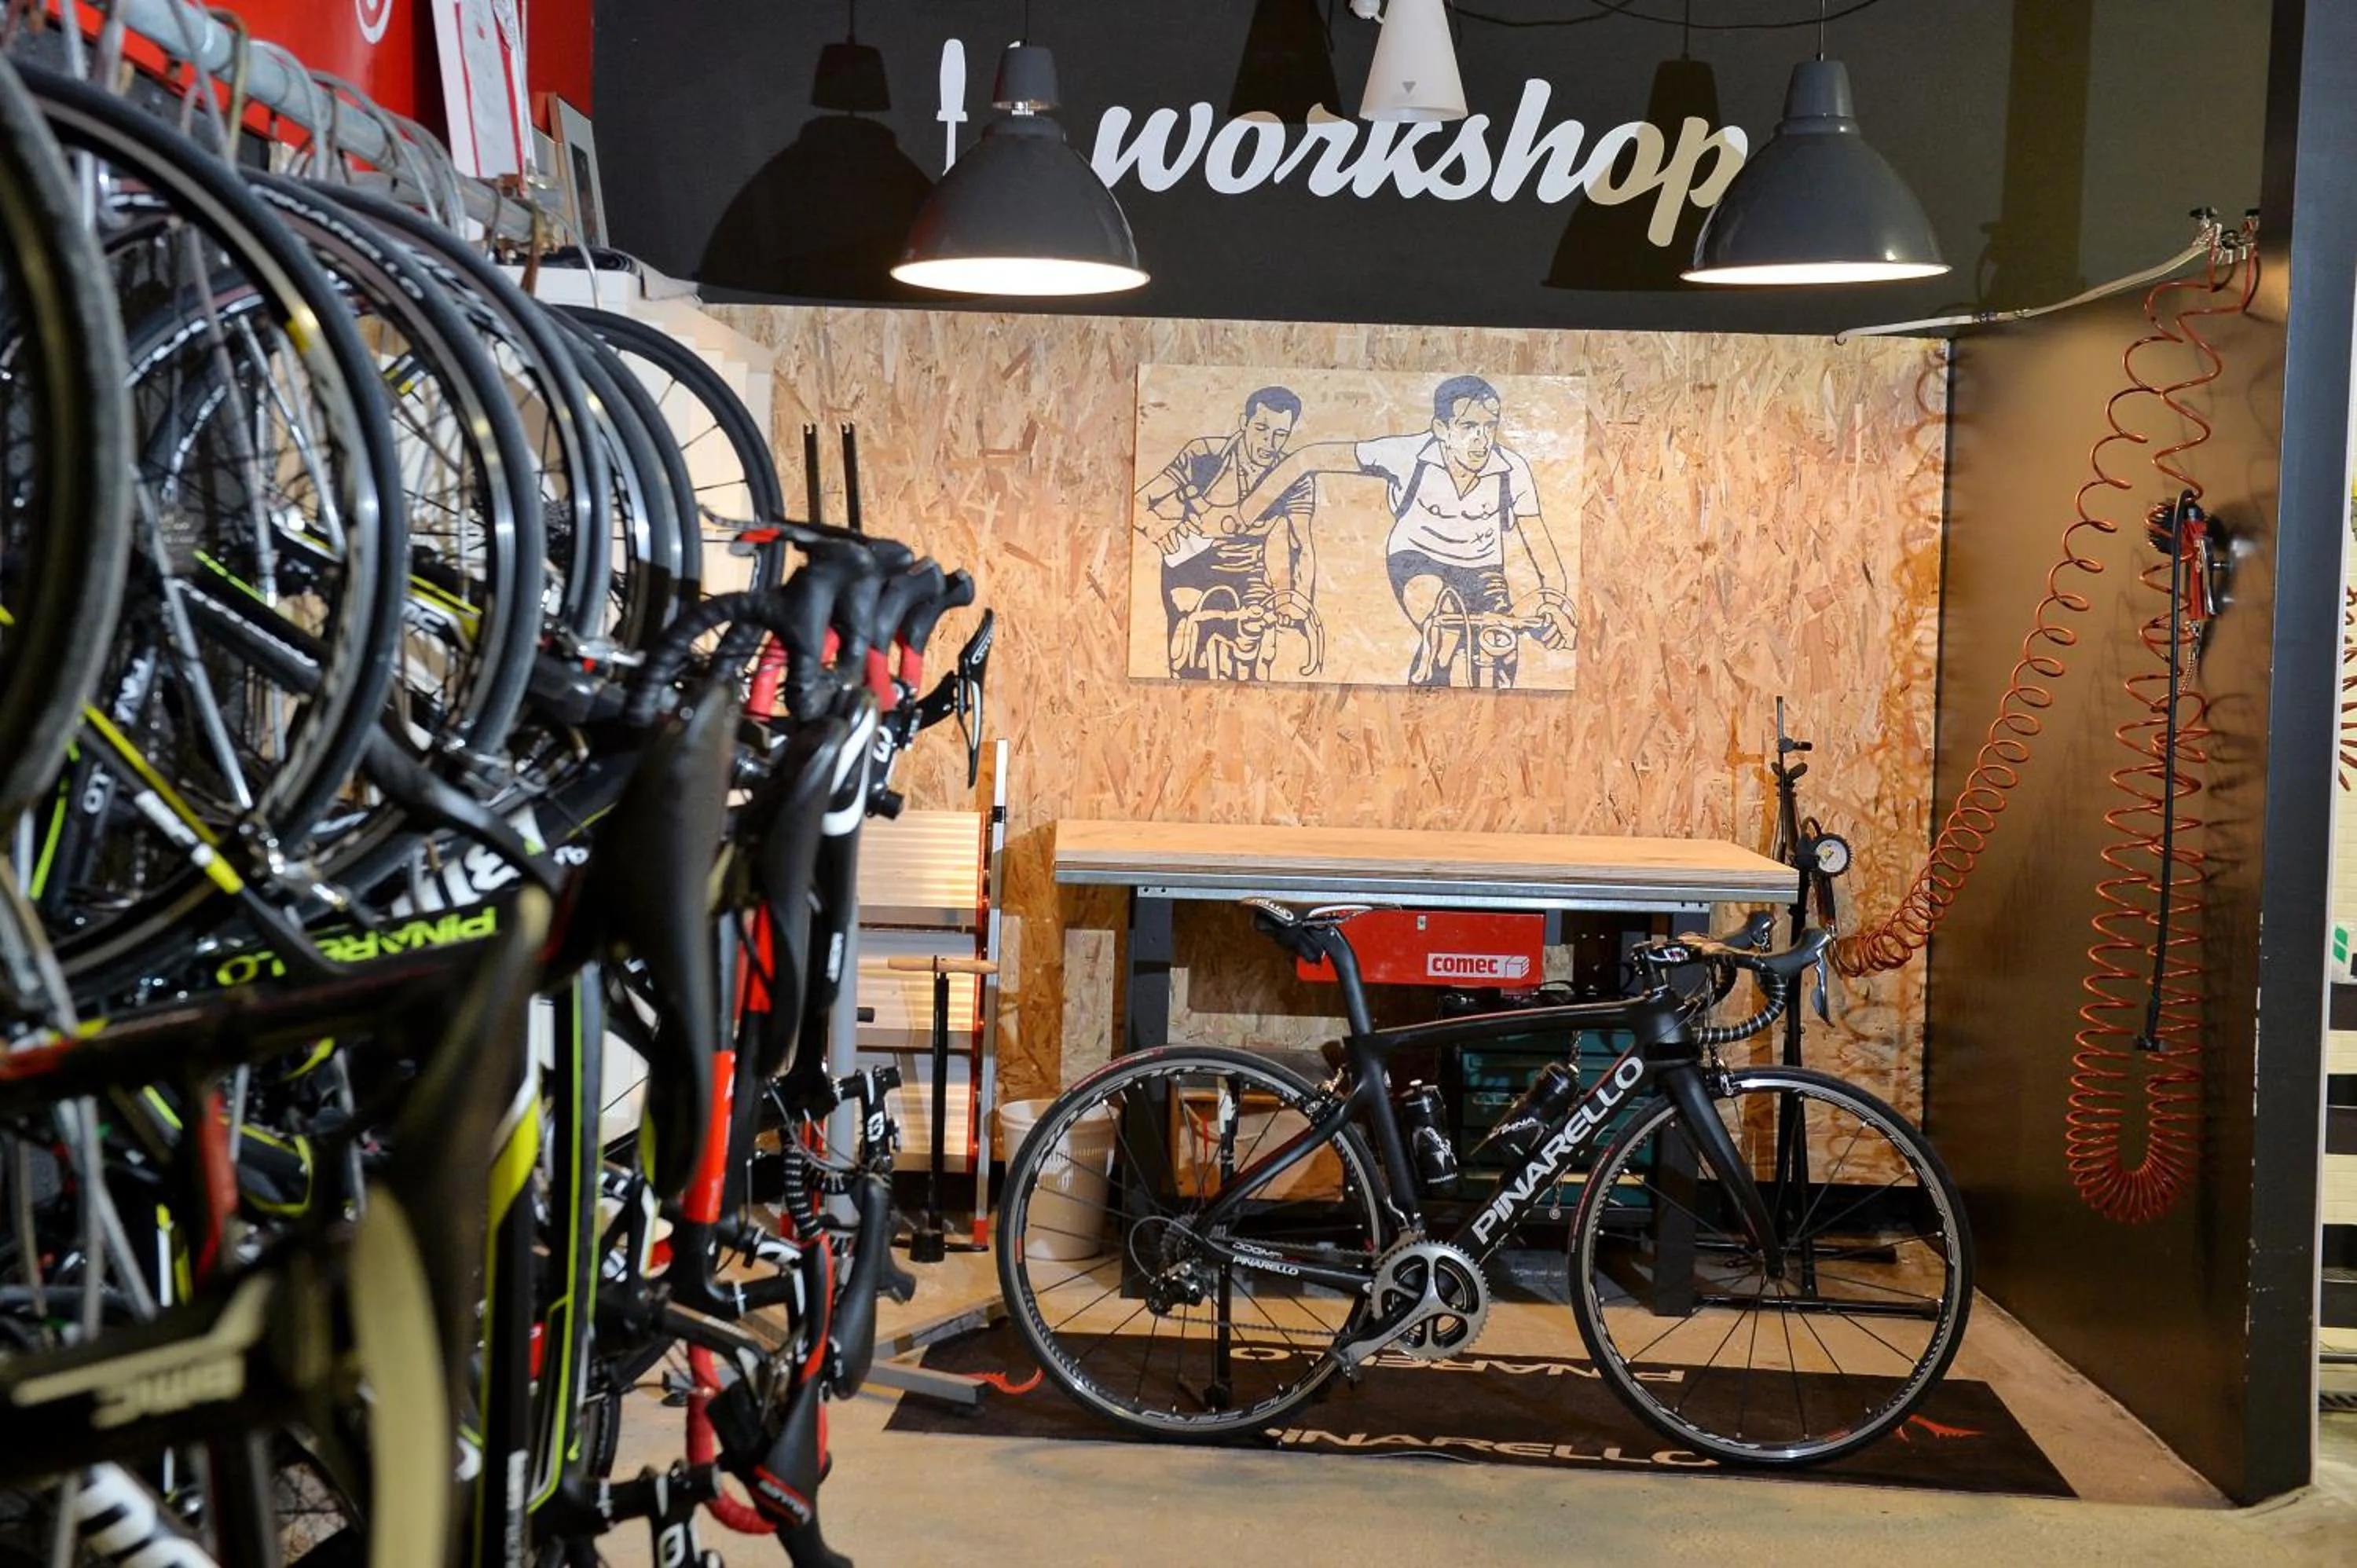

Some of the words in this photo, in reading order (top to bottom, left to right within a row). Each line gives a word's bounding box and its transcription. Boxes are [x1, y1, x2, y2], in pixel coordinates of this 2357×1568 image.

[1091, 78, 1749, 248] workshop
[1432, 956, 1498, 974] comec
[1472, 1056, 1644, 1246] PINARELLO
[1232, 1254, 1299, 1277] PINARELLO
